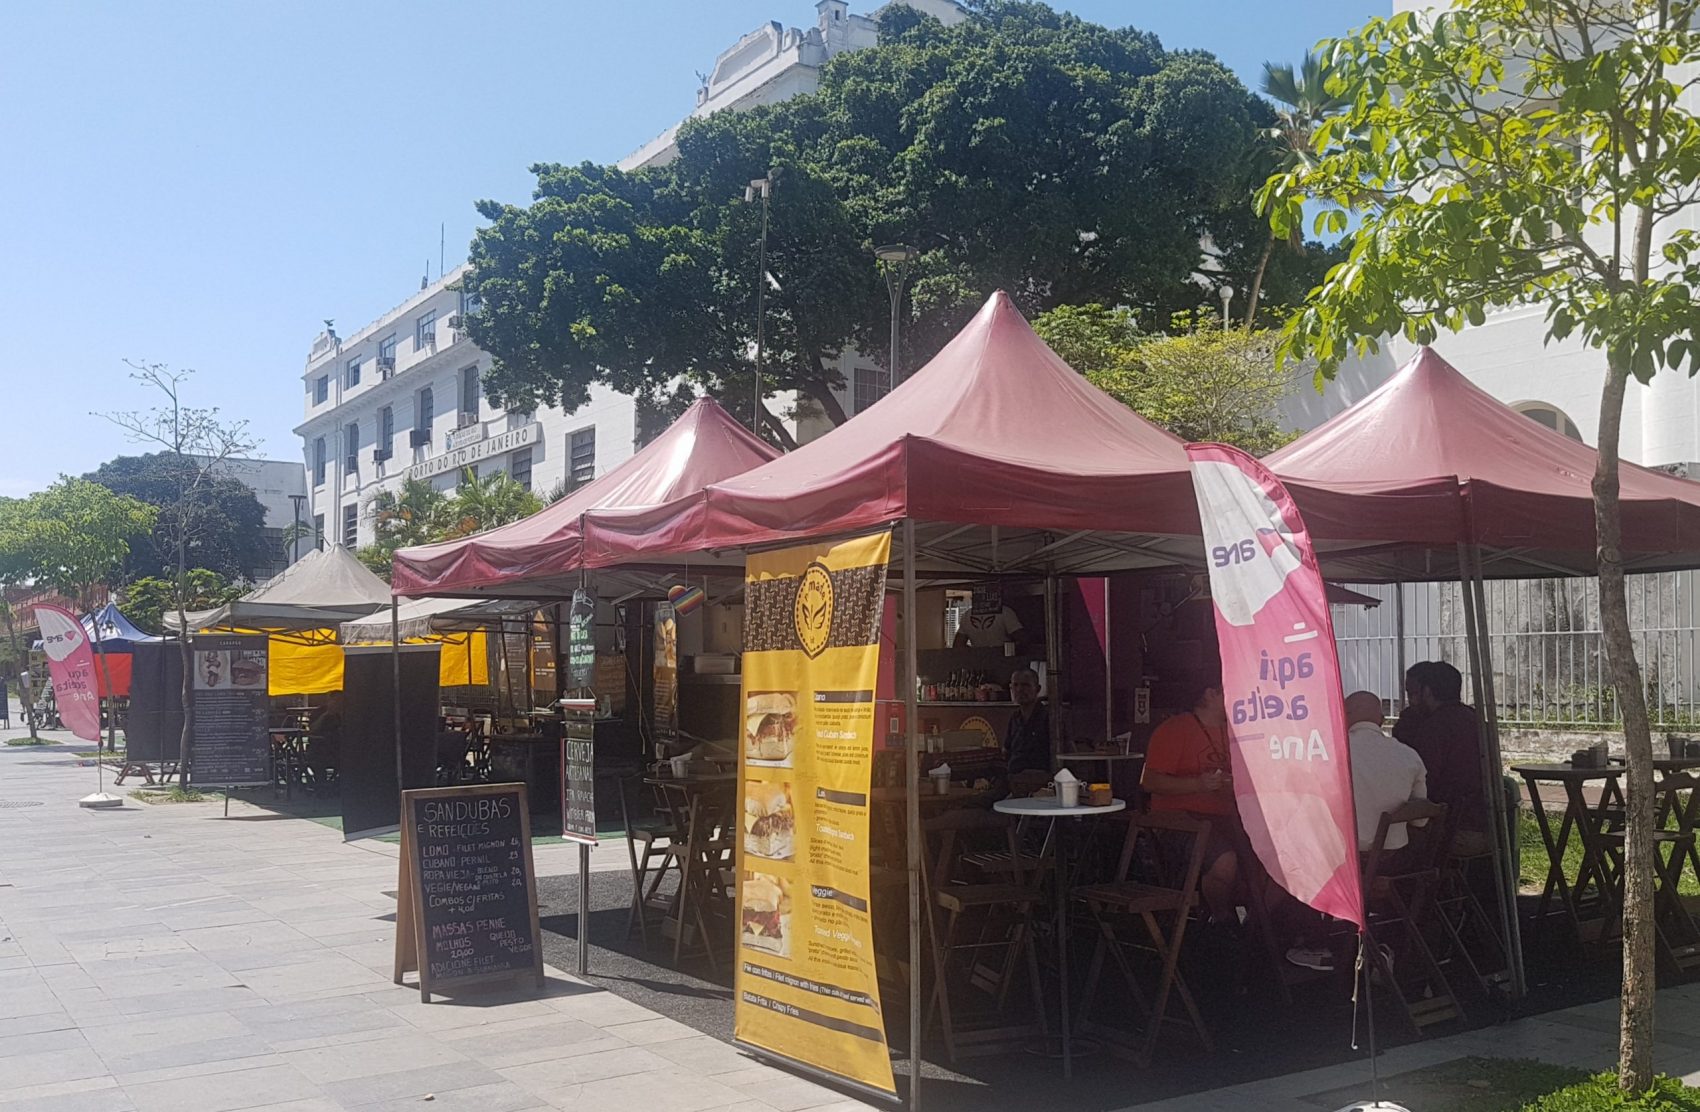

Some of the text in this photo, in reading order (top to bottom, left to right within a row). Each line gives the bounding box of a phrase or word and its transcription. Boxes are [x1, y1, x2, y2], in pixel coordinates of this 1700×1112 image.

[409, 463, 434, 479] PORTO
[438, 456, 449, 470] DO
[453, 450, 467, 465] RIO
[471, 444, 482, 459] DE
[487, 428, 528, 454] JANEIRO
[566, 740, 594, 763] CERVEJA
[423, 797, 511, 823] SANDUBAS
[417, 823, 424, 833] E
[423, 844, 449, 858] LOMO
[457, 843, 476, 853] FILET
[423, 856, 456, 869] CUBANO
[460, 854, 491, 867] PERNIL
[432, 917, 506, 939] MASSAS PENNE
[436, 937, 472, 951] MOLHOS
